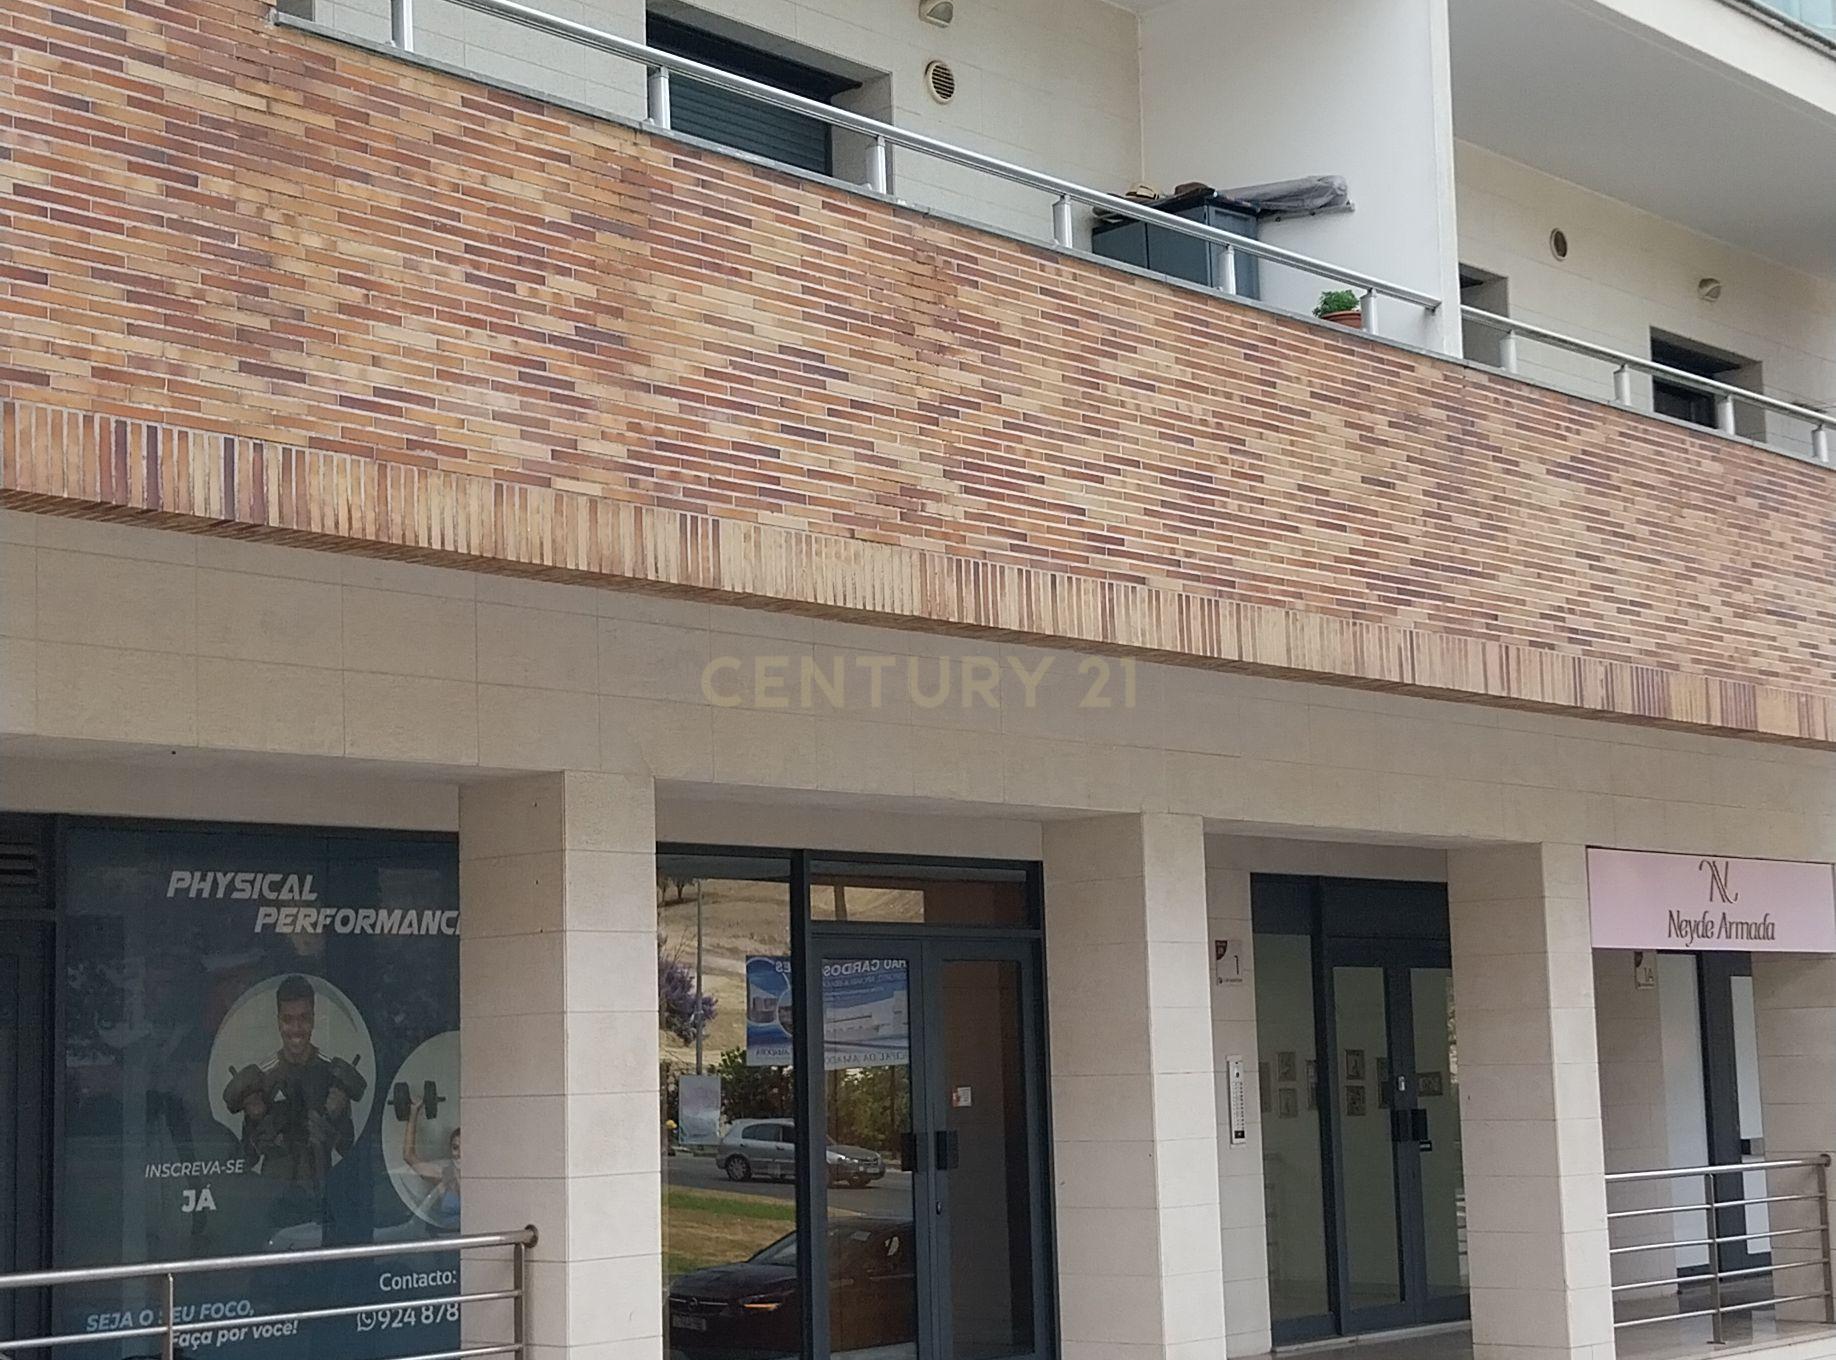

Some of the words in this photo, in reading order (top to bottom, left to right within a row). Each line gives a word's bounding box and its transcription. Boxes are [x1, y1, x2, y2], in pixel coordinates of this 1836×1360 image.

[166, 870, 318, 901] PHYSICAL
[254, 906, 460, 935] PERFORMANC
[1667, 910, 1714, 947] Neyde
[1716, 912, 1776, 941] Armada
[145, 1159, 245, 1178] INSCREVA-SE
[181, 1183, 217, 1213] JÁ
[379, 1270, 457, 1292] Contacto:
[86, 1311, 133, 1332] SEJA
[139, 1309, 154, 1327] O
[158, 1304, 195, 1325] EU
[200, 1299, 255, 1320] FOCO,
[377, 1307, 417, 1330] 924
[215, 1326, 248, 1348] por
